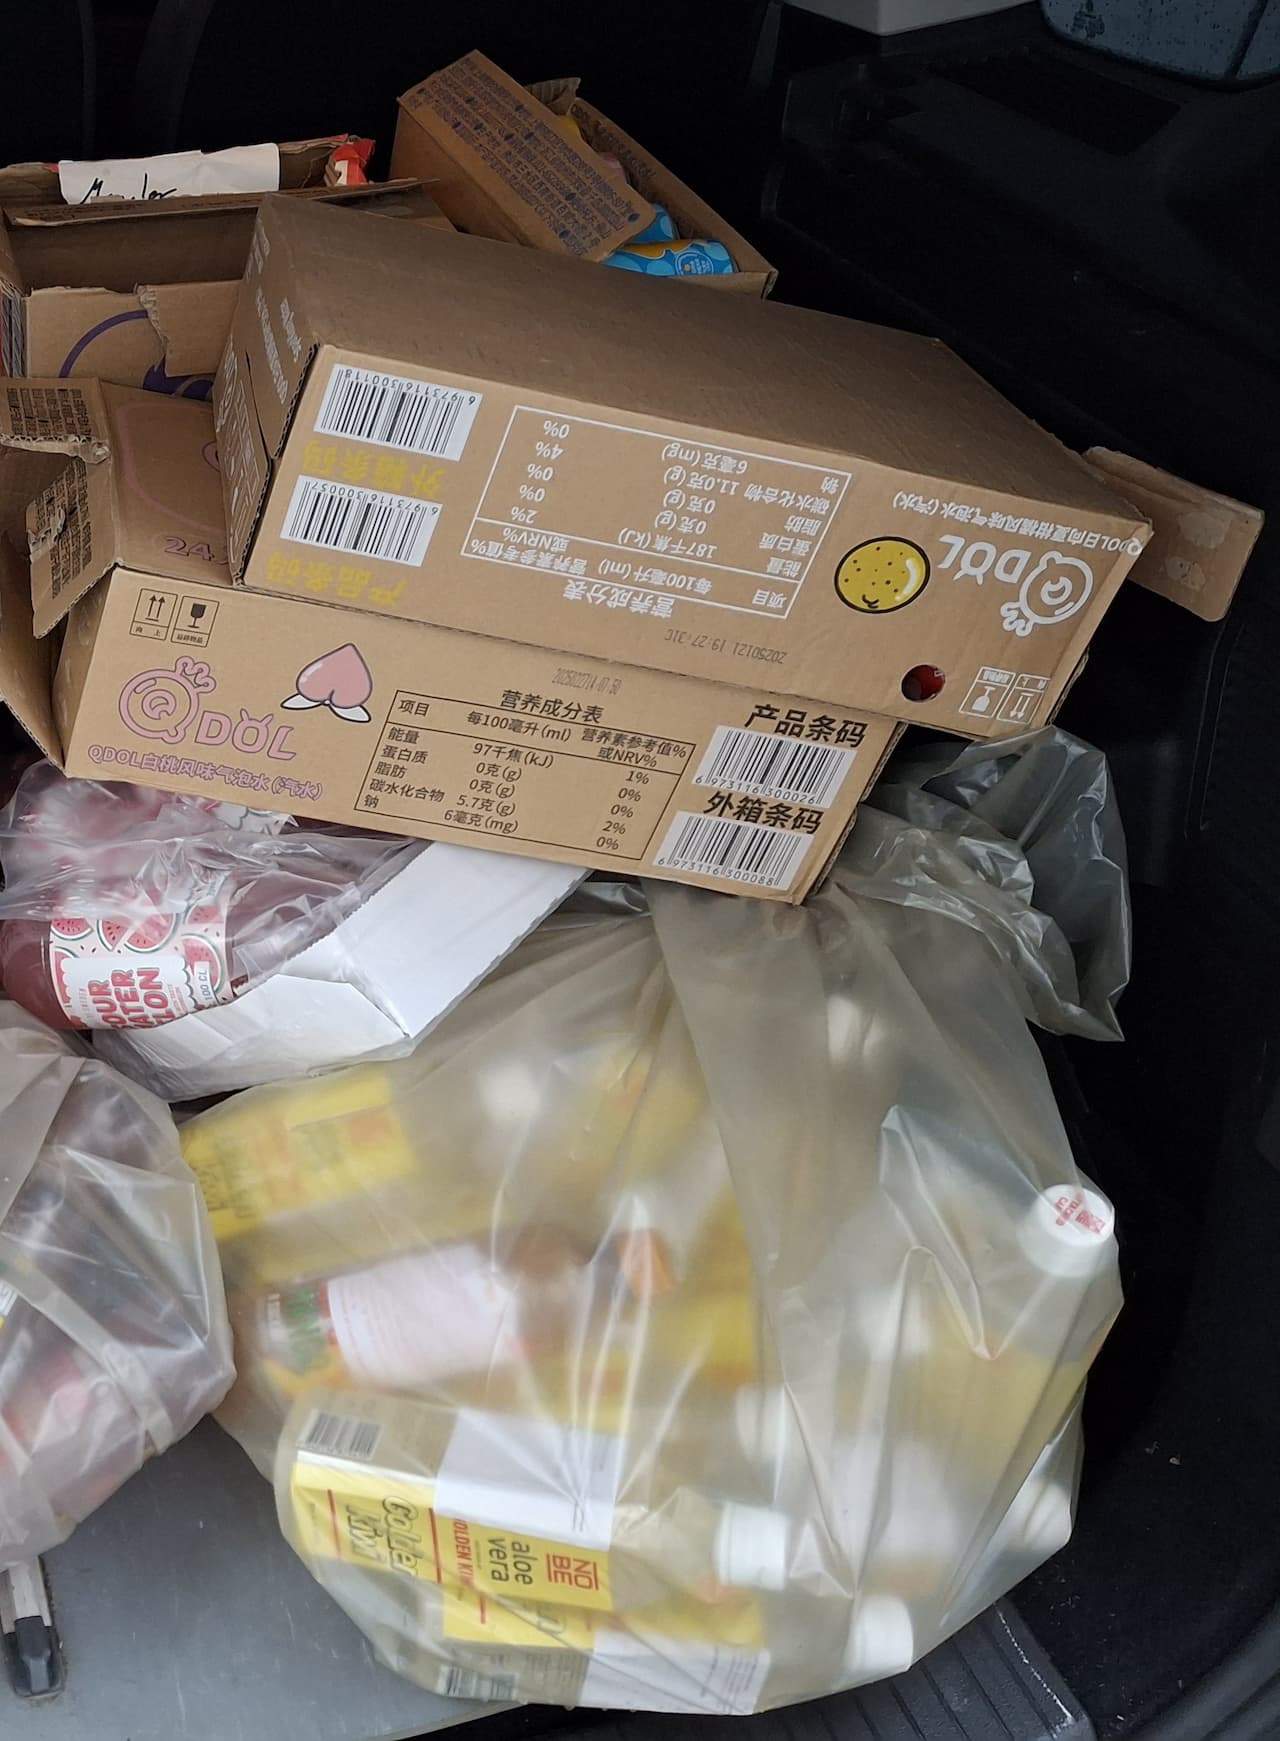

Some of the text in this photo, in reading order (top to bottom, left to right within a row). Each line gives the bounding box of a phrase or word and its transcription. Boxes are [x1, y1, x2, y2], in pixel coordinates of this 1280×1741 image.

[344, 369, 401, 391] 300118
[405, 381, 459, 402] 973116
[543, 420, 570, 438] 0%
[535, 441, 565, 460] 4%
[527, 463, 554, 481] 0%
[312, 482, 365, 502] 300057
[370, 493, 422, 512] 973116
[519, 485, 546, 503] 0%
[744, 484, 831, 516] 碳水化合物
[511, 506, 539, 525] 2%
[783, 515, 822, 536] 脂肪
[758, 532, 813, 555] 蛋白质
[765, 557, 803, 578] 能量
[563, 579, 677, 619] 营养成分表
[751, 589, 788, 610] 项目
[119, 655, 297, 761] QDOL
[499, 689, 605, 724] 营养成分表
[398, 699, 430, 717] 项目
[580, 727, 687, 758] 营养素参考值%
[744, 704, 869, 748] 产品条码
[388, 727, 420, 745] 能量
[625, 770, 649, 785] 1%
[598, 746, 658, 768] 或NRV%
[382, 745, 428, 765] 蛋白质
[618, 788, 642, 802] 0%
[374, 762, 407, 779] 脂肪
[611, 804, 634, 818] 0%
[710, 777, 760, 794] 973116
[765, 787, 816, 805] 300026
[369, 778, 445, 803] 碳水化合物
[603, 820, 627, 835] 2%
[703, 791, 825, 835] 外箱条码
[363, 794, 380, 809] 钠
[596, 836, 619, 851] 0%
[672, 859, 720, 876] 973116
[725, 869, 775, 887] 300088
[488, 1538, 511, 1584] vera
[510, 1541, 539, 1586] aloe
